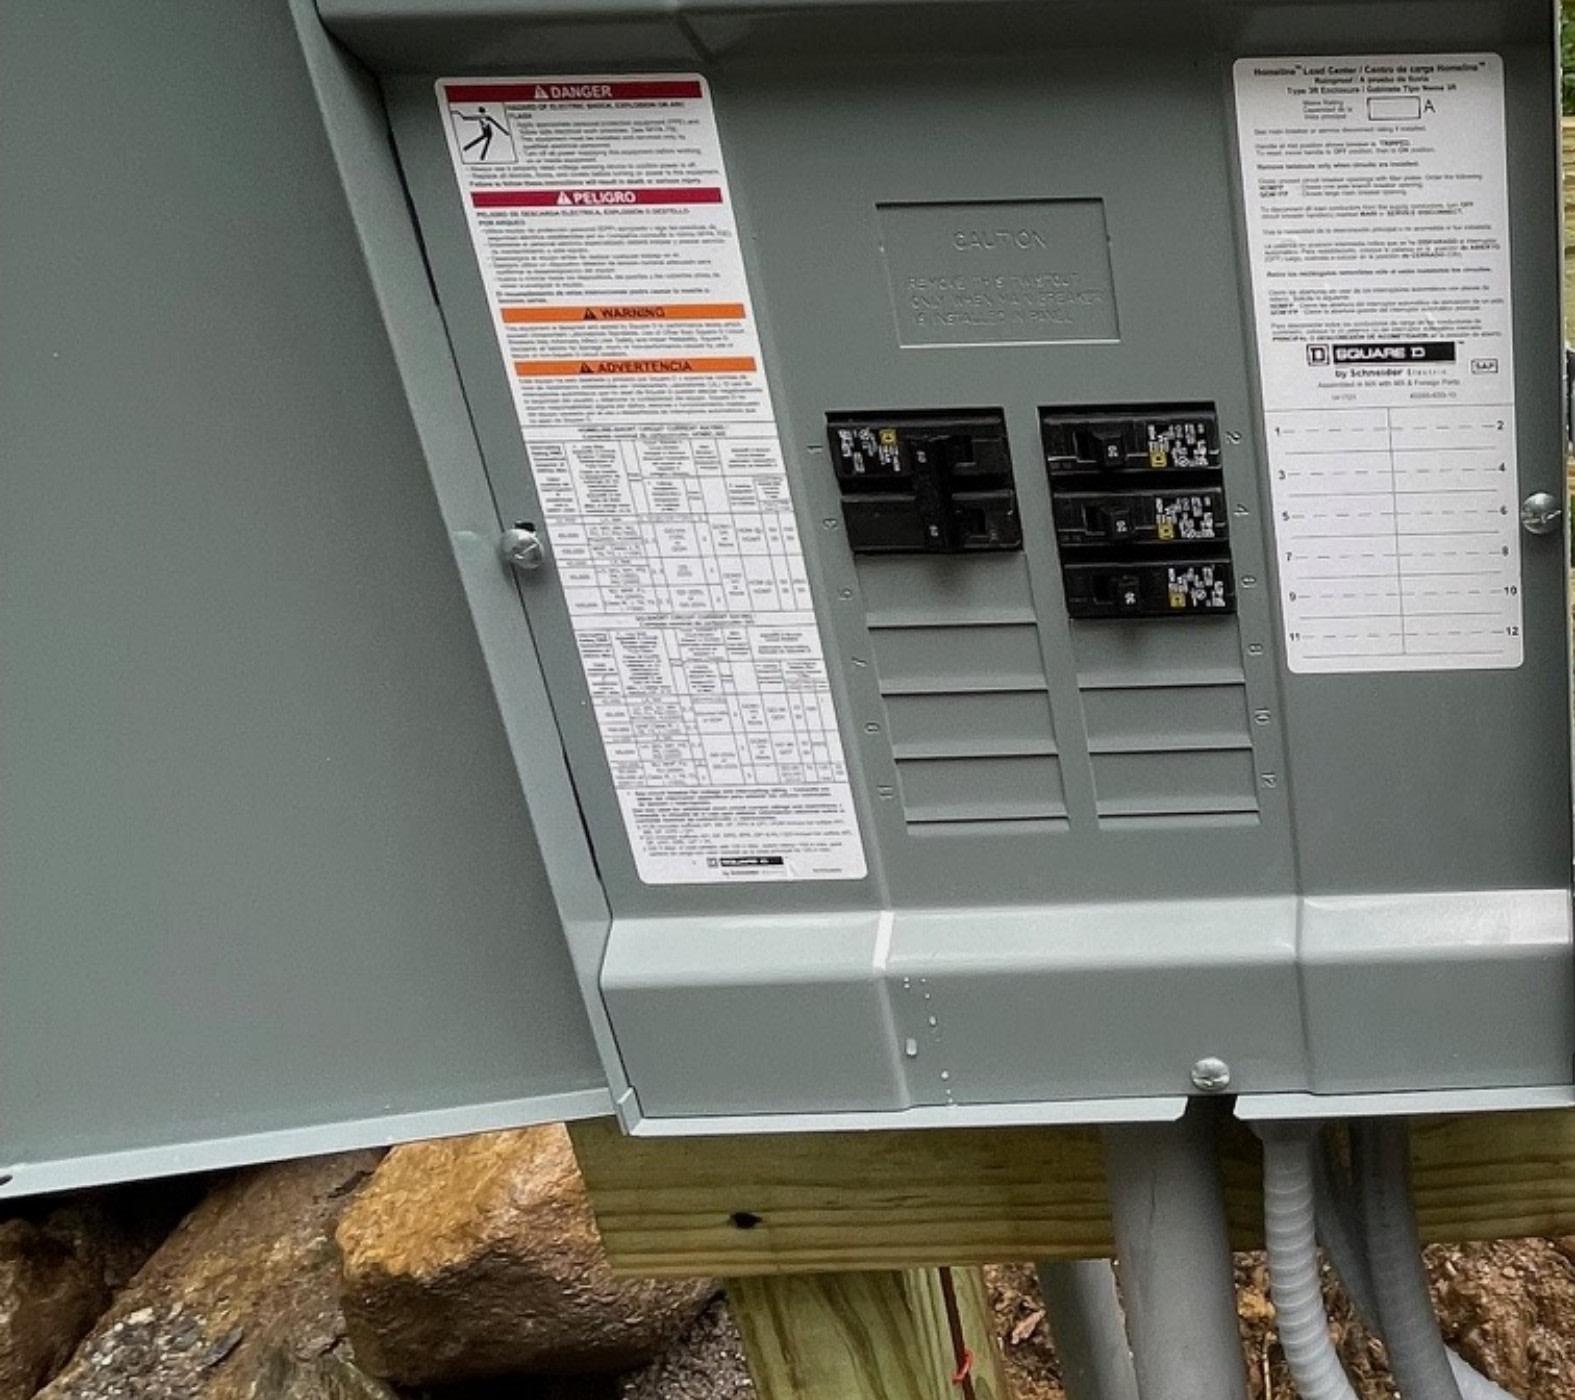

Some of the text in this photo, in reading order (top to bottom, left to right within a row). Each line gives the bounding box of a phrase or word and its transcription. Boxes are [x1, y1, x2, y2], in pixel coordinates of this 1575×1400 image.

[549, 84, 613, 99] DANGER
[1423, 99, 1436, 113] A
[573, 190, 636, 205] PELIGRO
[953, 227, 1047, 251] CAUTION
[601, 306, 666, 319] WARNING
[1335, 347, 1405, 360] SQUARE
[1410, 347, 1426, 358] D
[598, 360, 692, 374] ADVERTENCIA
[1335, 369, 1347, 379] by
[1350, 368, 1403, 378] Schneider
[1496, 420, 1504, 430] 2
[1274, 426, 1281, 436] 1
[1497, 462, 1506, 472] 4
[1278, 470, 1286, 480] 3
[1500, 505, 1507, 515] 6
[1281, 511, 1290, 521] 5
[1501, 546, 1509, 556] 8
[1286, 552, 1293, 562] 7
[1504, 585, 1518, 596] 10
[1289, 592, 1296, 602] 9
[1505, 626, 1519, 636] 12
[1289, 632, 1301, 641] 11
